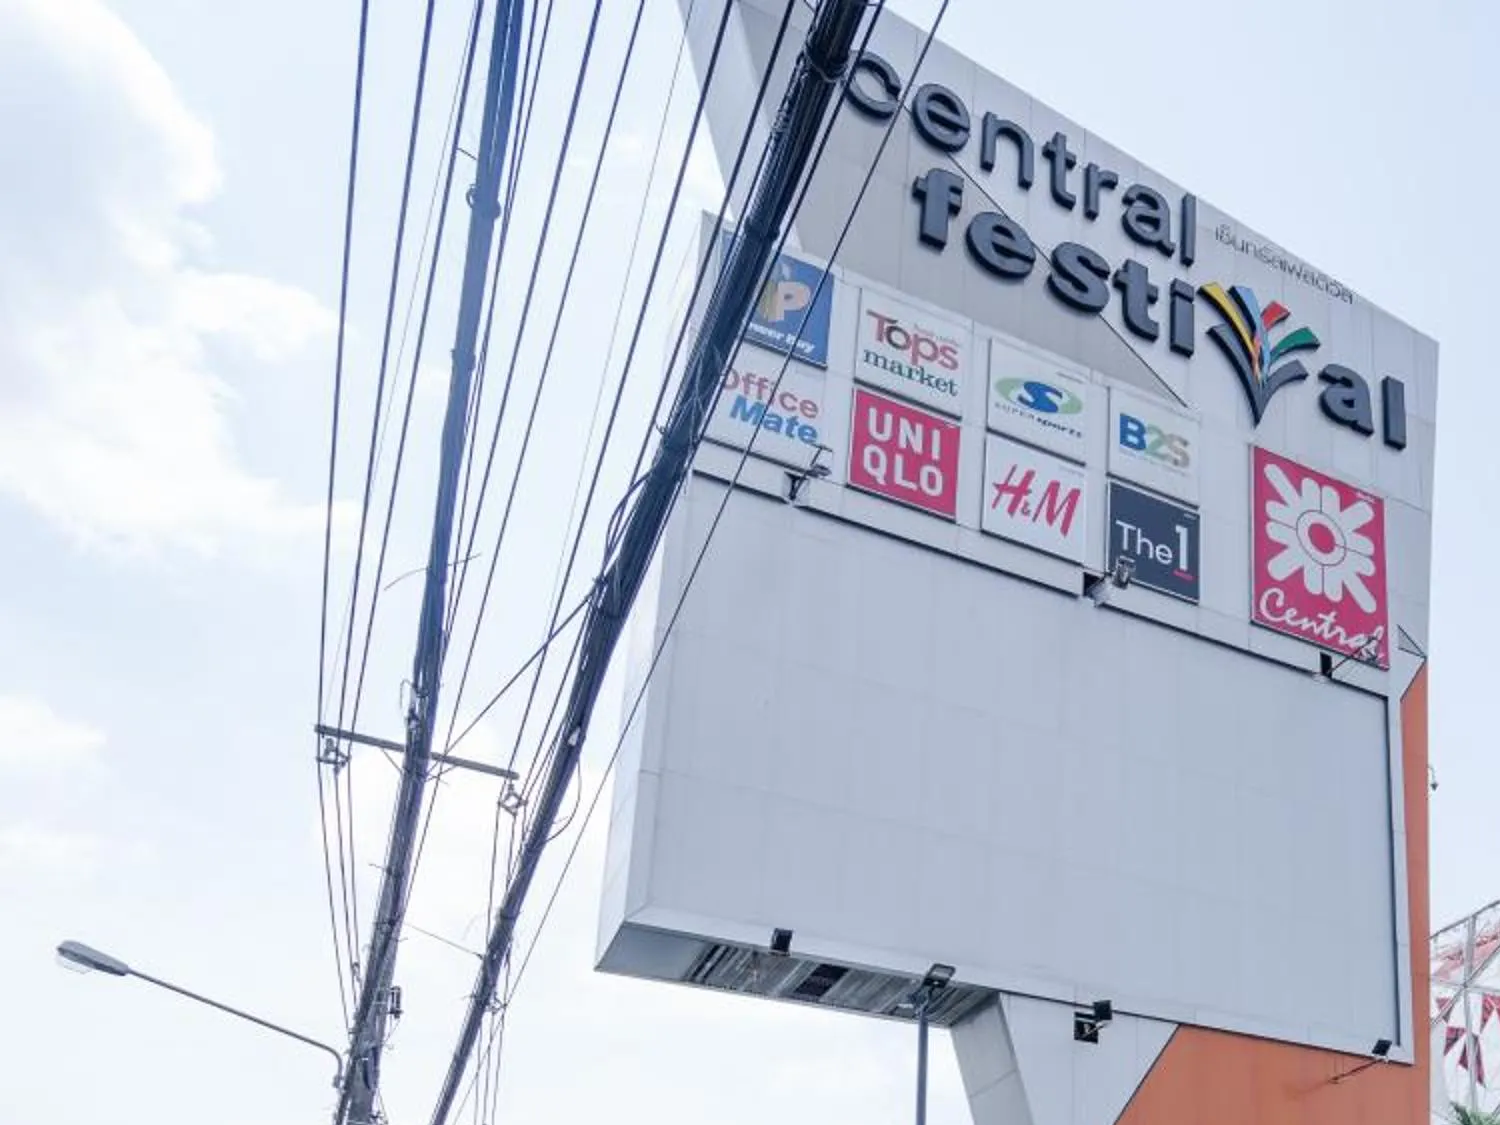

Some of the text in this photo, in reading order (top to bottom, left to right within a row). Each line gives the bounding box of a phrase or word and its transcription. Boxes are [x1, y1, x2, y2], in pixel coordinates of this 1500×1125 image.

[843, 50, 1198, 267] central
[866, 309, 959, 370] Tops
[863, 348, 958, 396] market
[729, 394, 818, 444] Mate
[868, 407, 941, 460] UNI
[1119, 412, 1190, 468] B2S
[863, 444, 943, 497] QLO
[992, 464, 1081, 537] H&M
